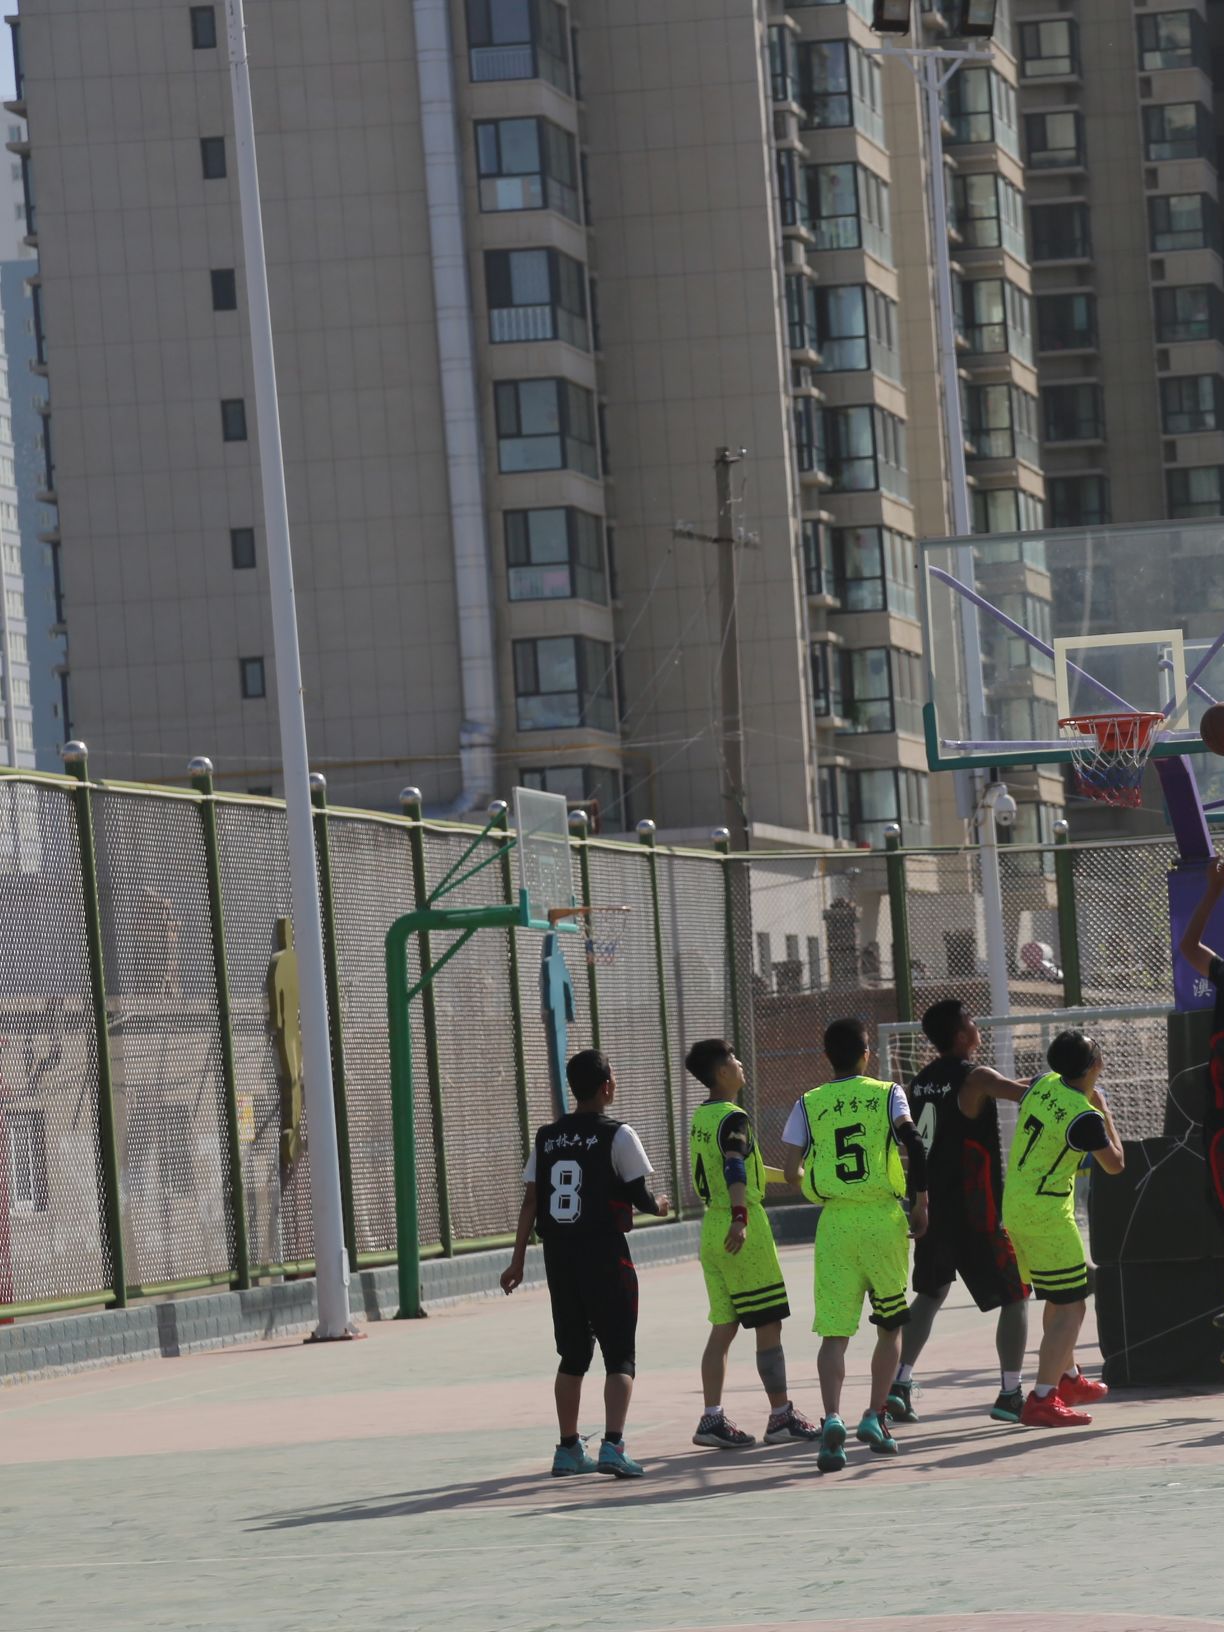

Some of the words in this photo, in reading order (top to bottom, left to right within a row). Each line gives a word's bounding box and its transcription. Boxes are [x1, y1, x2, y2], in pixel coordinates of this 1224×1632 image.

[834, 1122, 870, 1185] 5
[916, 1102, 937, 1158] 4
[1017, 1113, 1045, 1172] 7
[549, 1160, 583, 1224] 8
